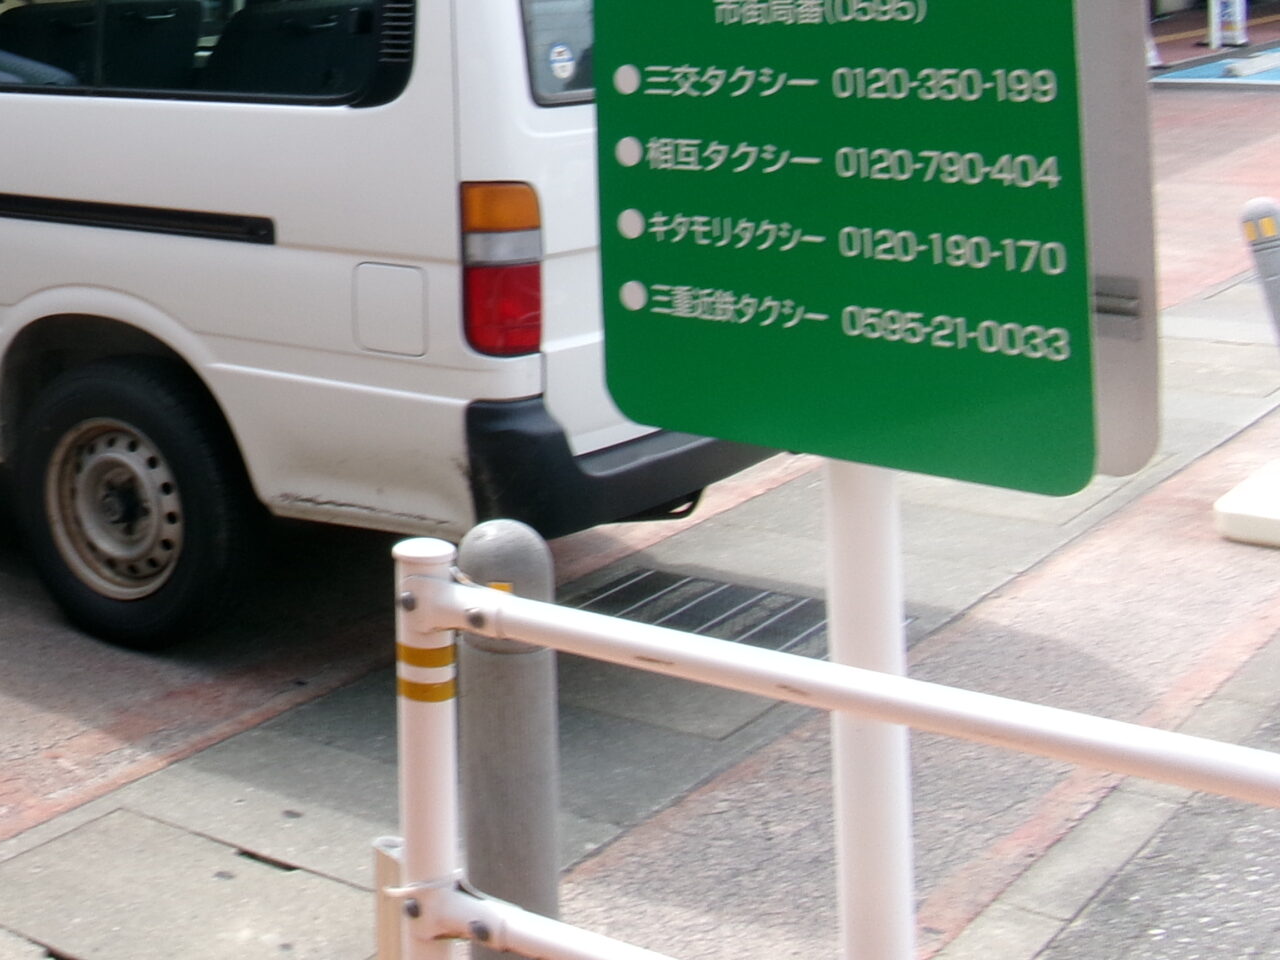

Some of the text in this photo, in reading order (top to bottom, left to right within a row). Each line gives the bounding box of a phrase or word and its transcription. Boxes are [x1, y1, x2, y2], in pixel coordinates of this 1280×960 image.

[643, 63, 1058, 103] 三交タクシー 0120-350-199
[645, 136, 1063, 189] 相互タクシー 0120-790-404
[648, 211, 1068, 276] キタモリタクシー 0120-190-170
[650, 284, 1072, 362] 三重近鉄タクシー 0595-21-0033
